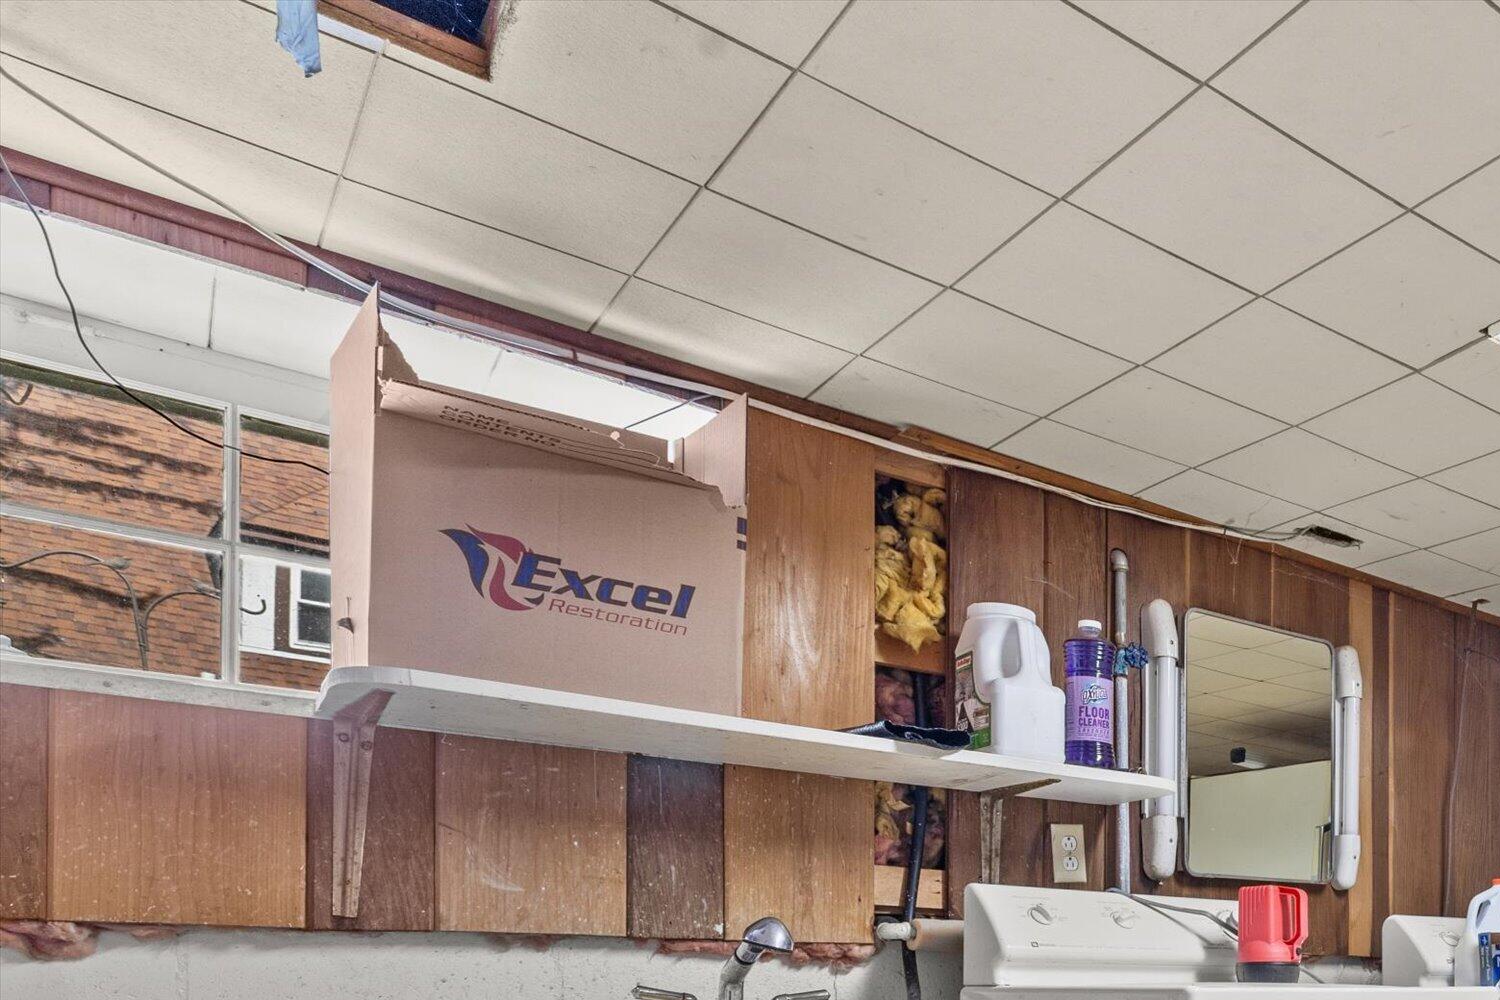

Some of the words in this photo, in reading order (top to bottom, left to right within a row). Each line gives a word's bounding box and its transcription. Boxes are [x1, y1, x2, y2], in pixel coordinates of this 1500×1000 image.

[439, 414, 519, 439] ORDER
[441, 410, 561, 444] CONTENTS
[444, 405, 510, 425] NAME
[511, 551, 696, 619] Excel
[549, 598, 688, 636] Restoration
[1078, 706, 1110, 720] FLOOR
[1078, 717, 1110, 729] CLEANER
